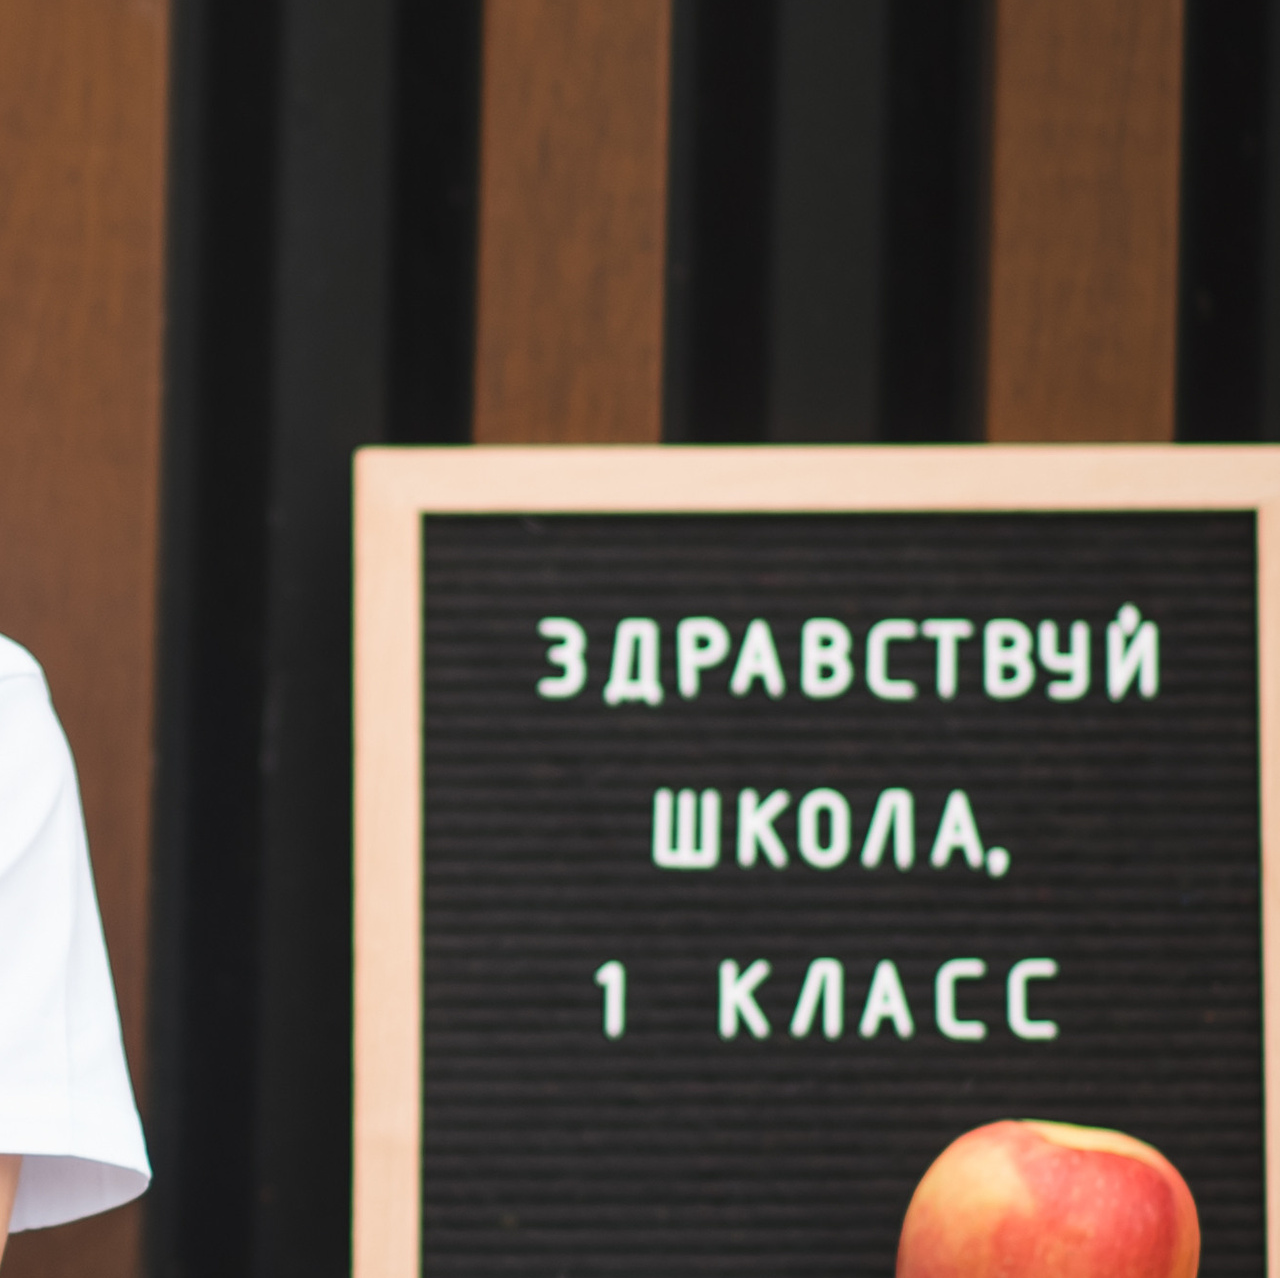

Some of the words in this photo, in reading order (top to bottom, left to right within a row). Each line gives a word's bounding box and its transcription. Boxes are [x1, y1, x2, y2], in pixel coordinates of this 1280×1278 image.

[537, 603, 1161, 705] ЗДРАВСТВУЙ
[651, 786, 1010, 878] ШКОЛА,
[595, 960, 626, 1039] 1
[718, 958, 1059, 1040] КЛАСС
